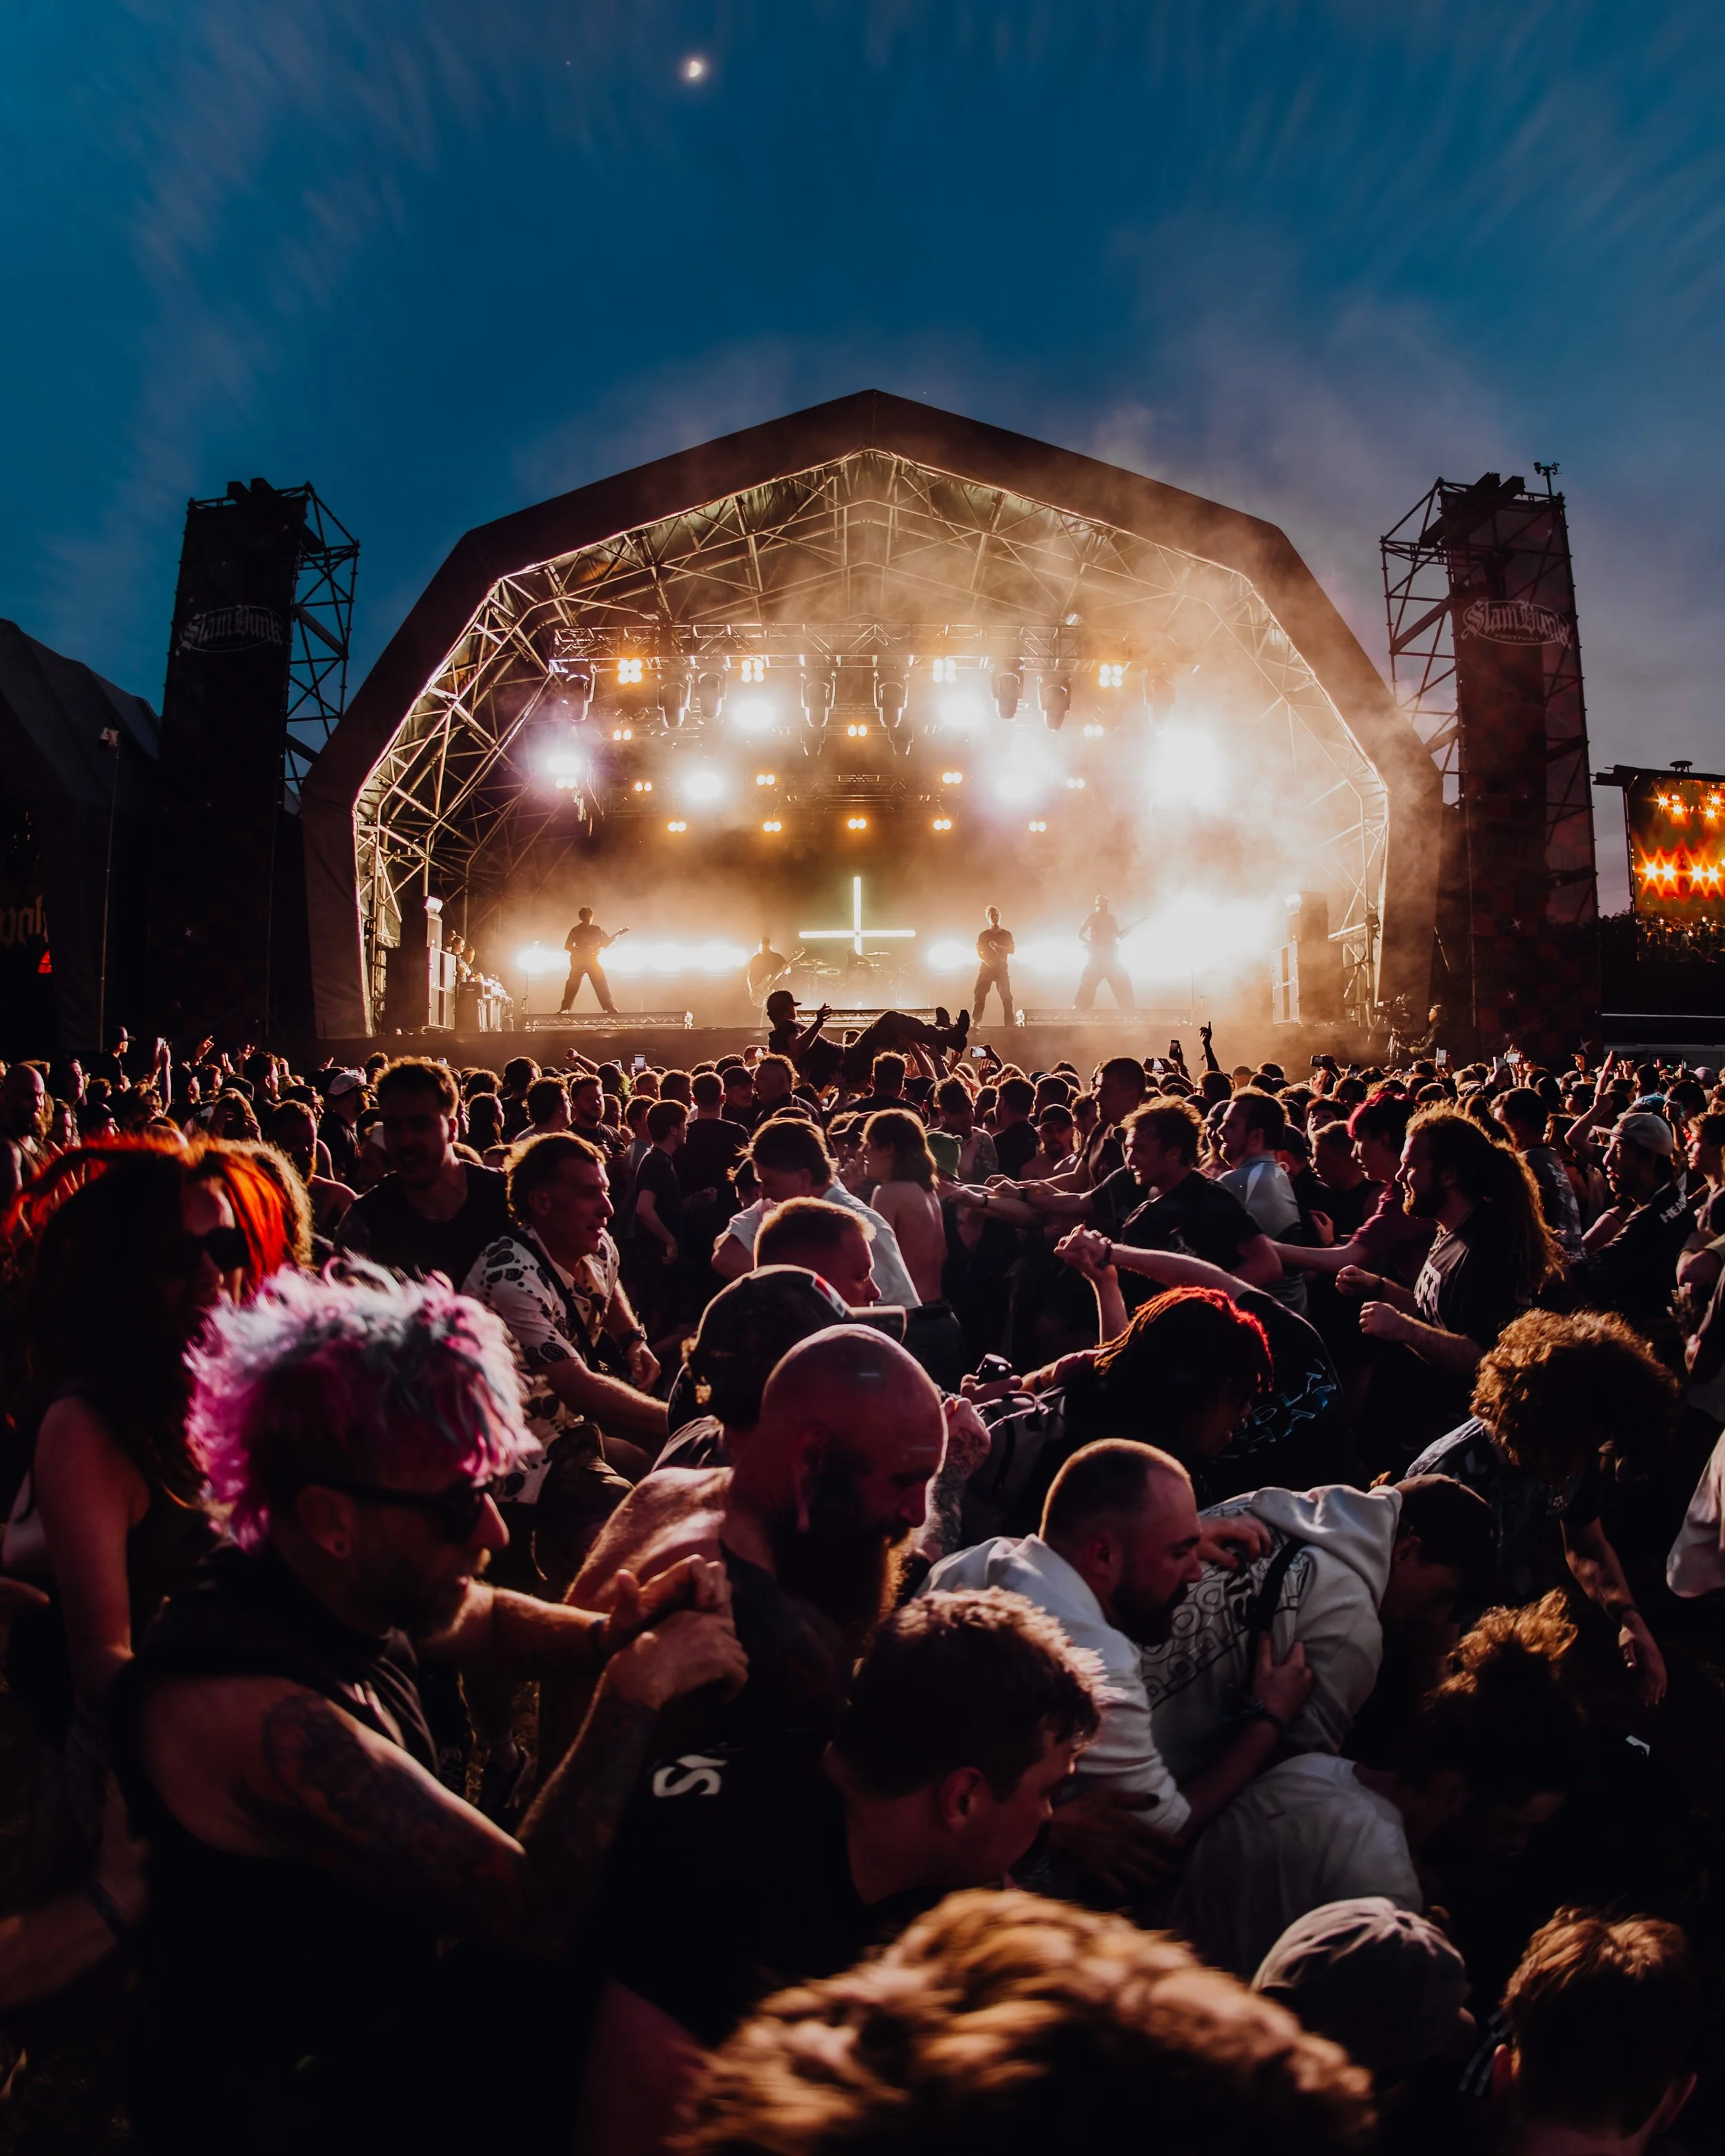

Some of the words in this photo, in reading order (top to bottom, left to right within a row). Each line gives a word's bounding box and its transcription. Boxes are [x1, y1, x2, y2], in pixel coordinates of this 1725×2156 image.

[175, 613, 232, 657] Slam
[233, 604, 284, 647] Dunk
[1461, 597, 1517, 641] Slam
[1515, 600, 1573, 651] Dunk
[1495, 633, 1541, 642] FESTIVAL
